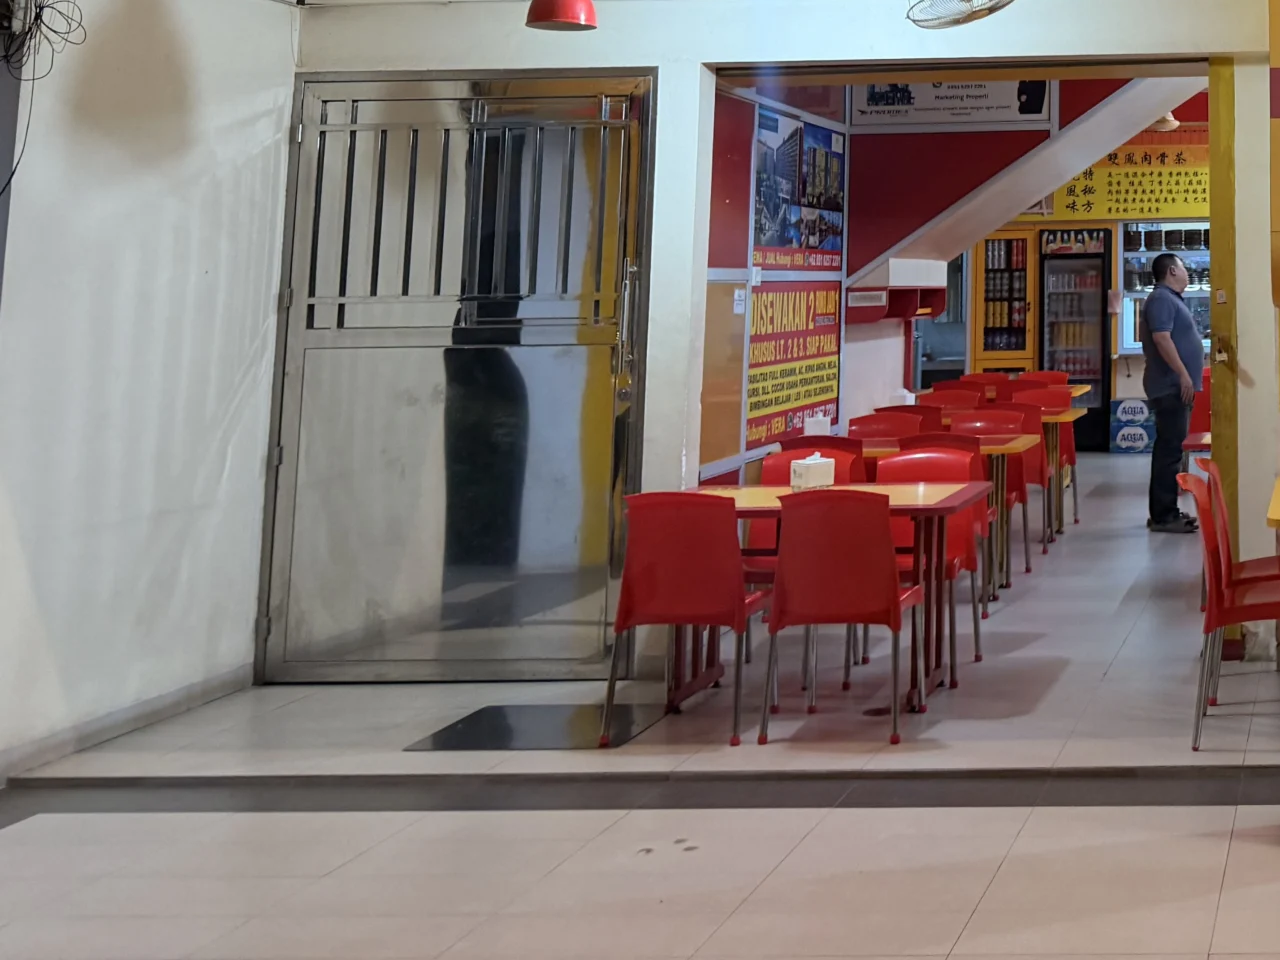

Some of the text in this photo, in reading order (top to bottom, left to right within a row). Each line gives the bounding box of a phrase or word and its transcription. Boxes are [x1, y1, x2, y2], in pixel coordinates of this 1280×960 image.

[750, 291, 807, 336] DISEWAKAN
[808, 291, 815, 330] 2
[750, 340, 776, 364] KHUSUS
[787, 338, 793, 359] 2
[1121, 405, 1144, 418] AQUA
[771, 415, 786, 435] VERA
[1120, 432, 1144, 444] AQUA
